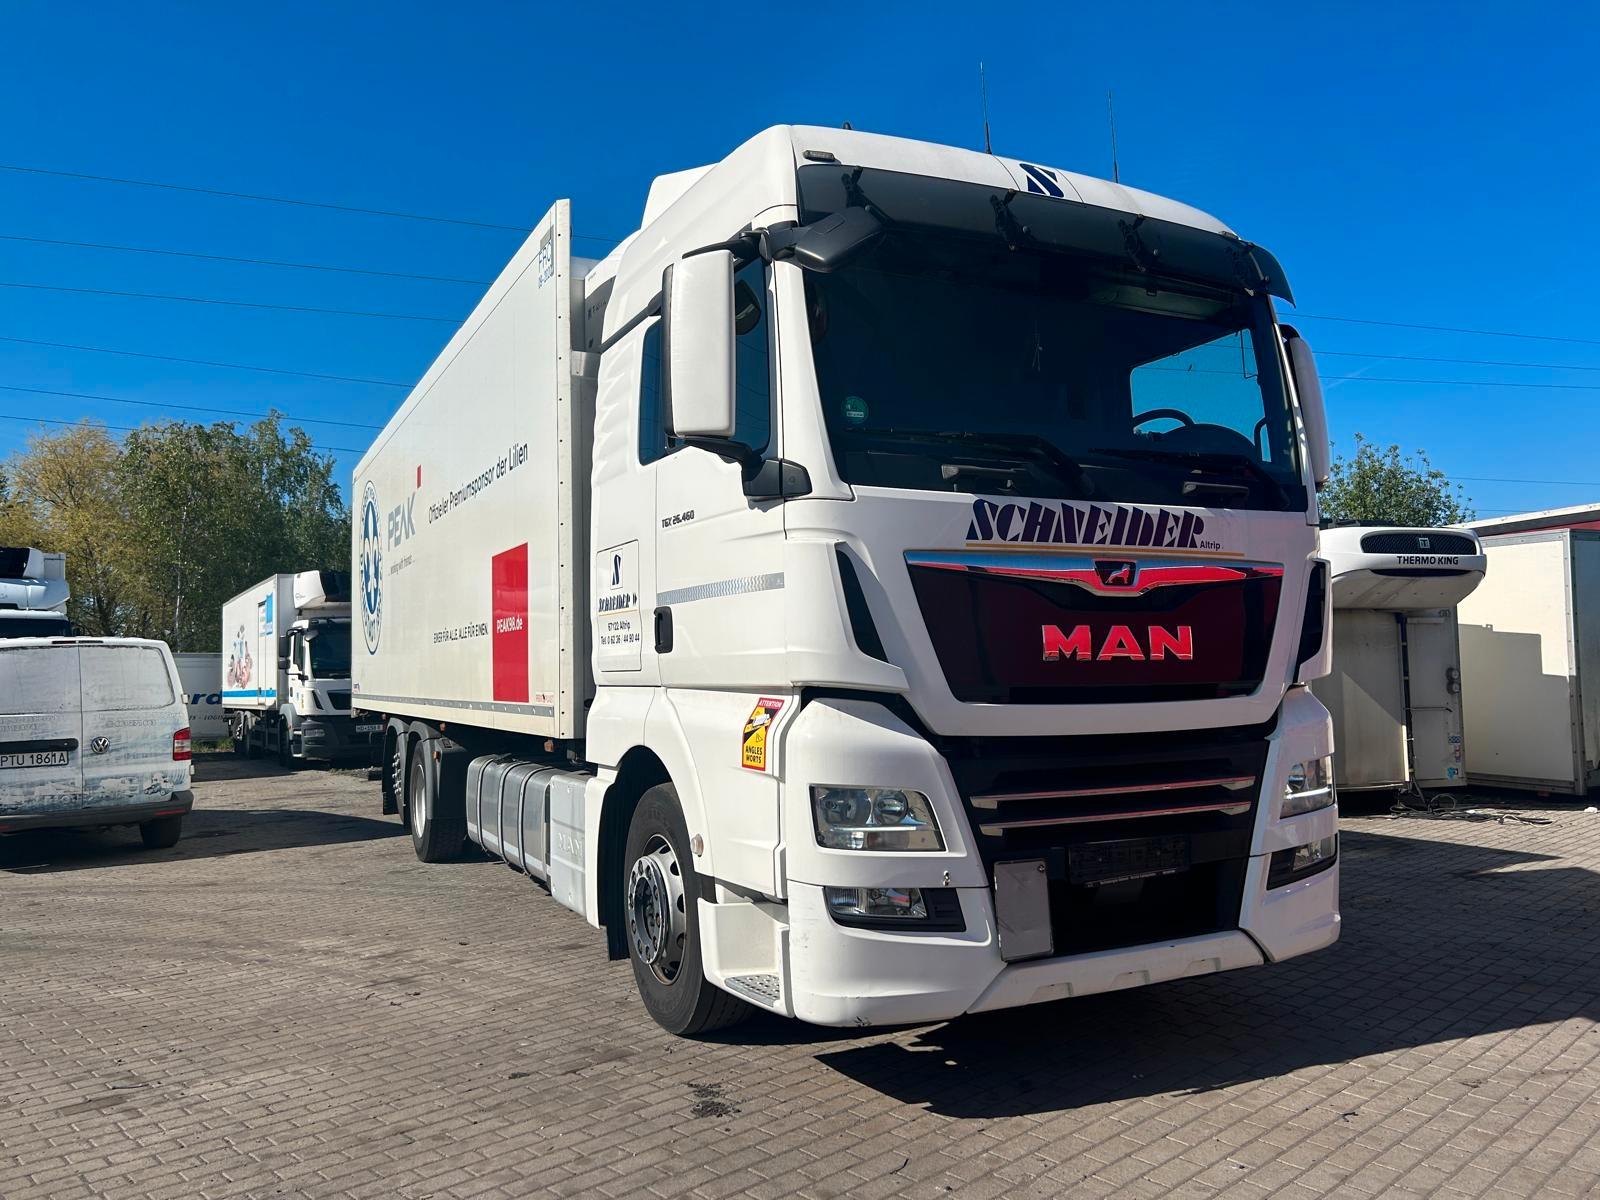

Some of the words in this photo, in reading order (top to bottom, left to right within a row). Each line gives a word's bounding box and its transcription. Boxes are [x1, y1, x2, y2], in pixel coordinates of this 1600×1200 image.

[428, 497, 449, 524] Offizieller
[449, 464, 496, 511] Premiumsponsor
[495, 455, 507, 480] der
[509, 441, 528, 471] Lilien
[387, 491, 416, 553] PEAK
[965, 498, 1205, 549] SCHNEIDER
[1200, 540, 1221, 551] Altrip
[1396, 555, 1436, 566] THERMO
[1438, 556, 1459, 566] KING
[496, 613, 523, 634] PEAK98.de
[1042, 624, 1194, 662] MAN
[0, 755, 25, 767] PTU
[29, 752, 66, 765] 1861A
[745, 745, 762, 756] ANGLES
[745, 755, 762, 764] MORTS
